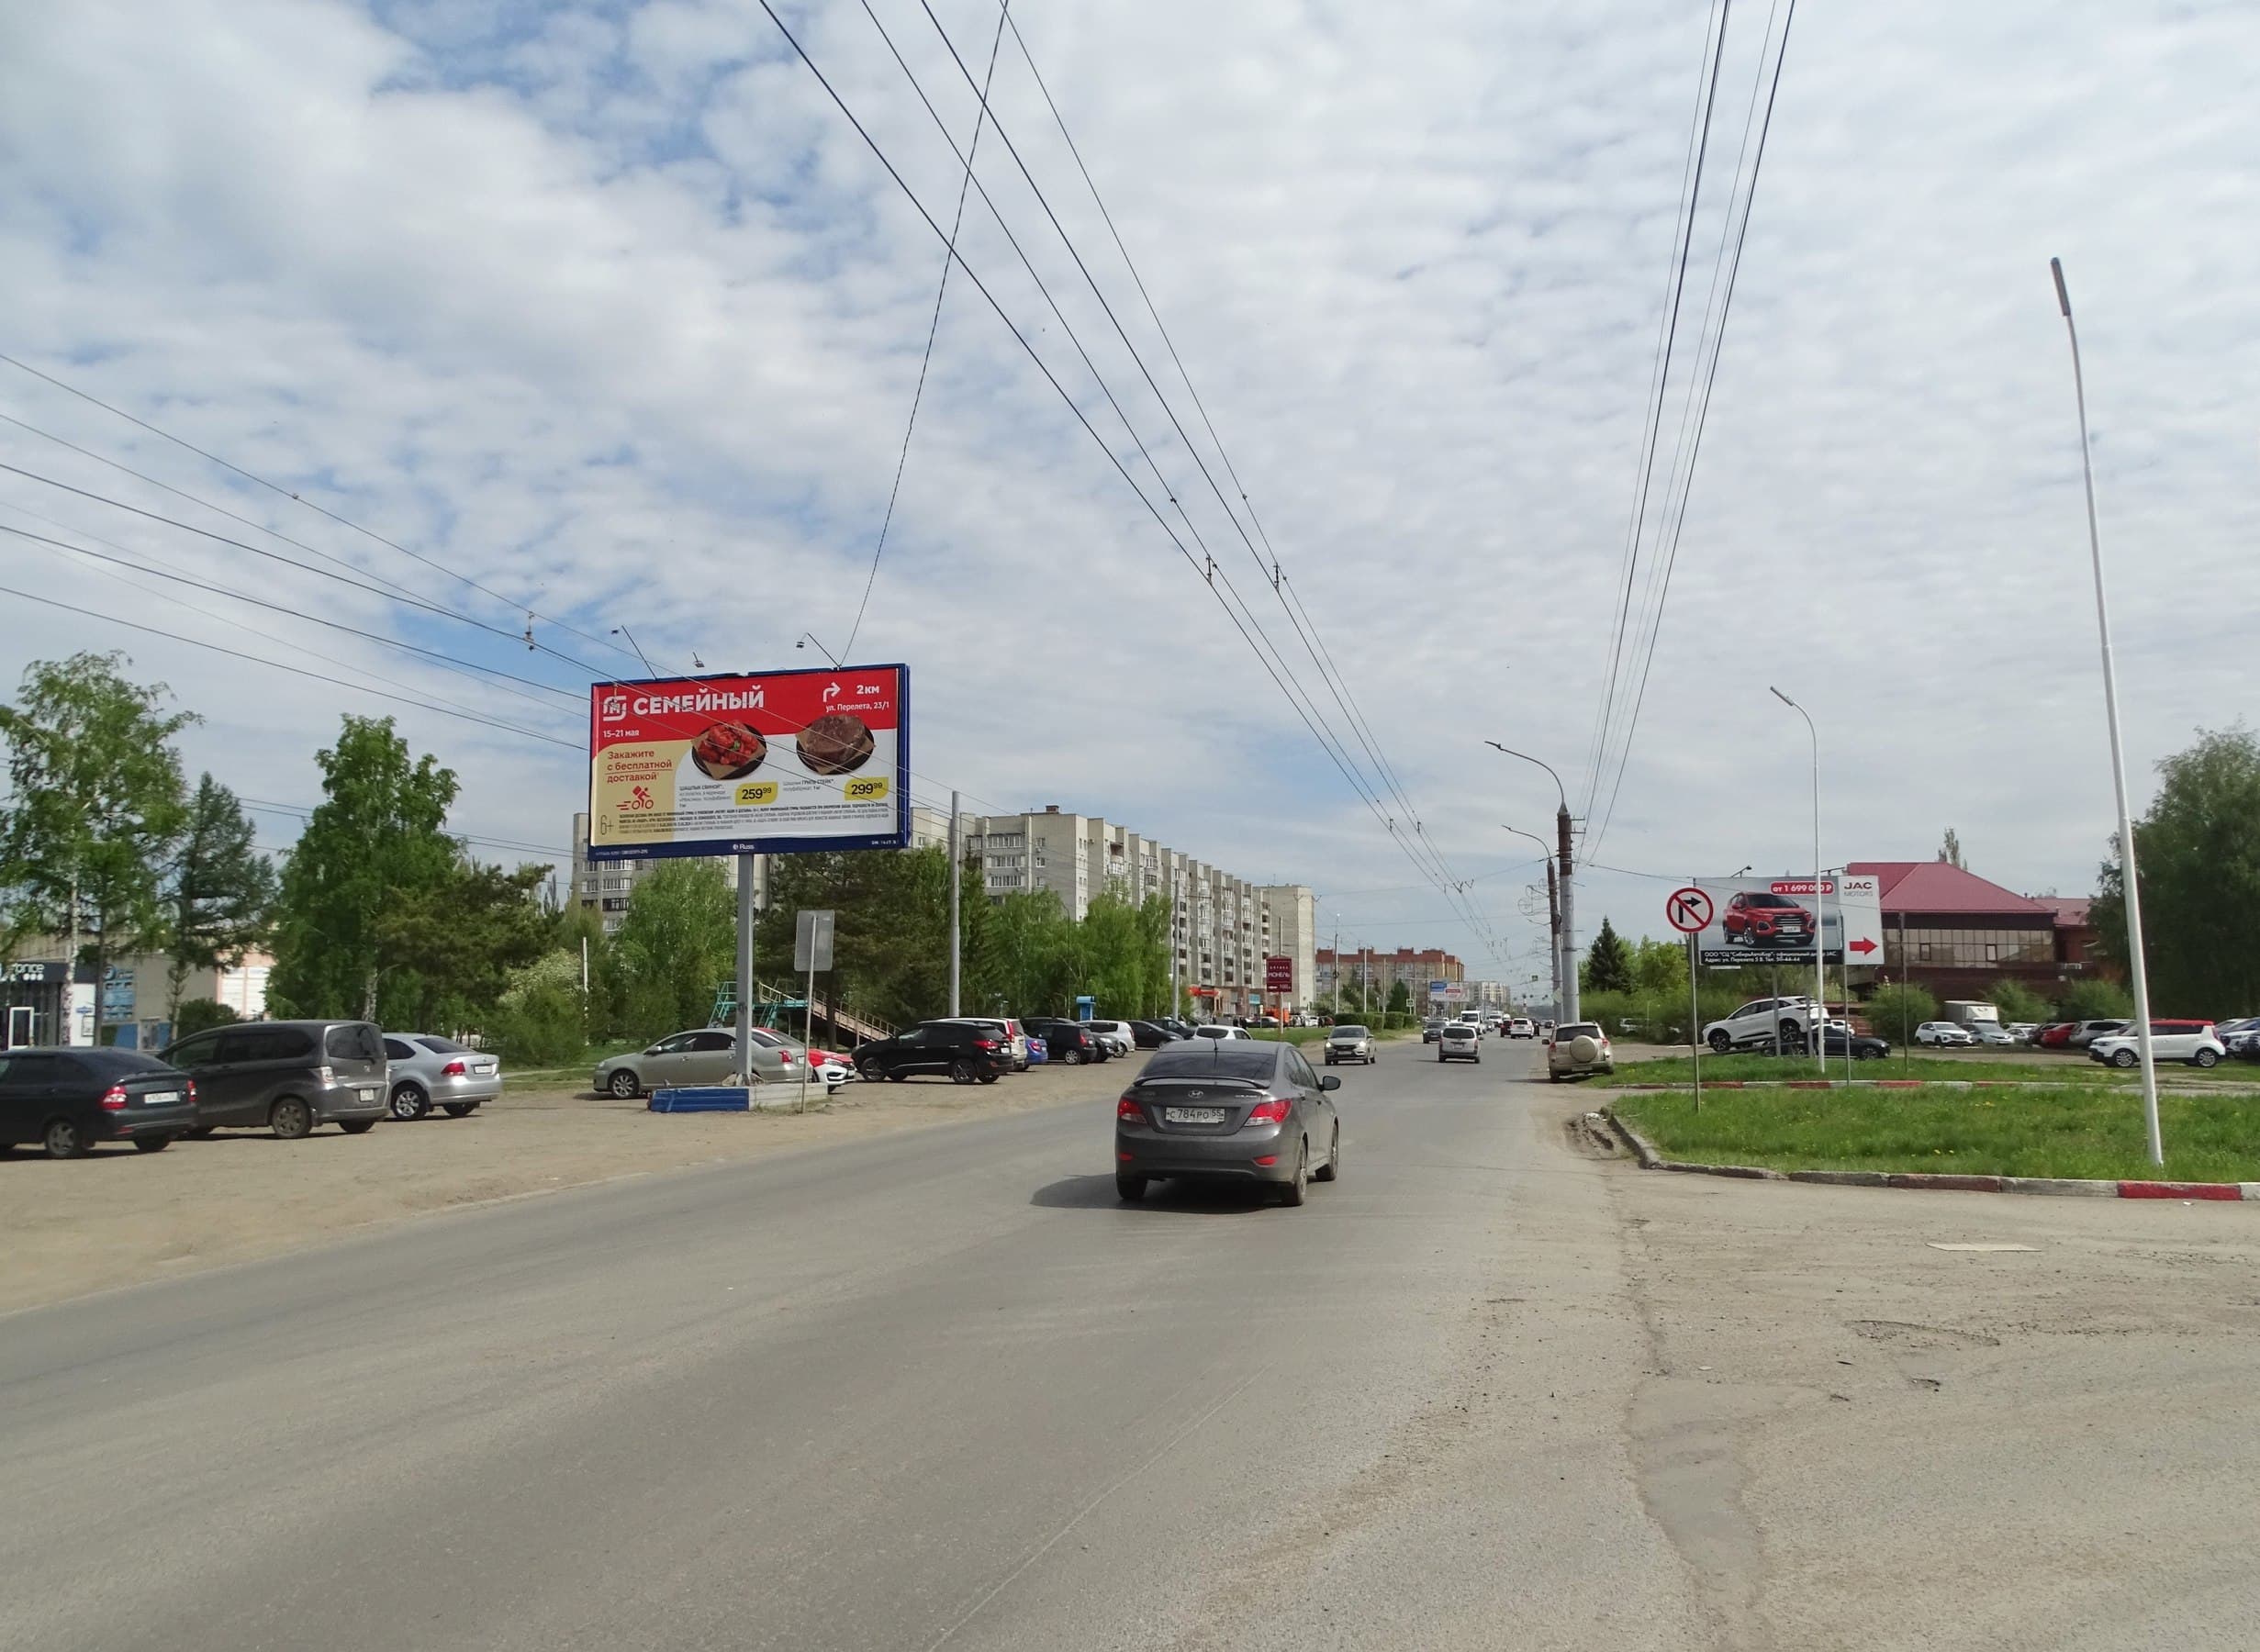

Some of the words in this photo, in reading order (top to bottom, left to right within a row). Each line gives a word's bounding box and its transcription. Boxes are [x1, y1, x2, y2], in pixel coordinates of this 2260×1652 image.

[633, 685, 764, 715] СЕМЕЙНЫЙ
[608, 750, 655, 760] Закажите
[615, 760, 672, 770] бесплатной
[600, 814, 613, 835] 6+
[1844, 881, 1873, 889] JAC
